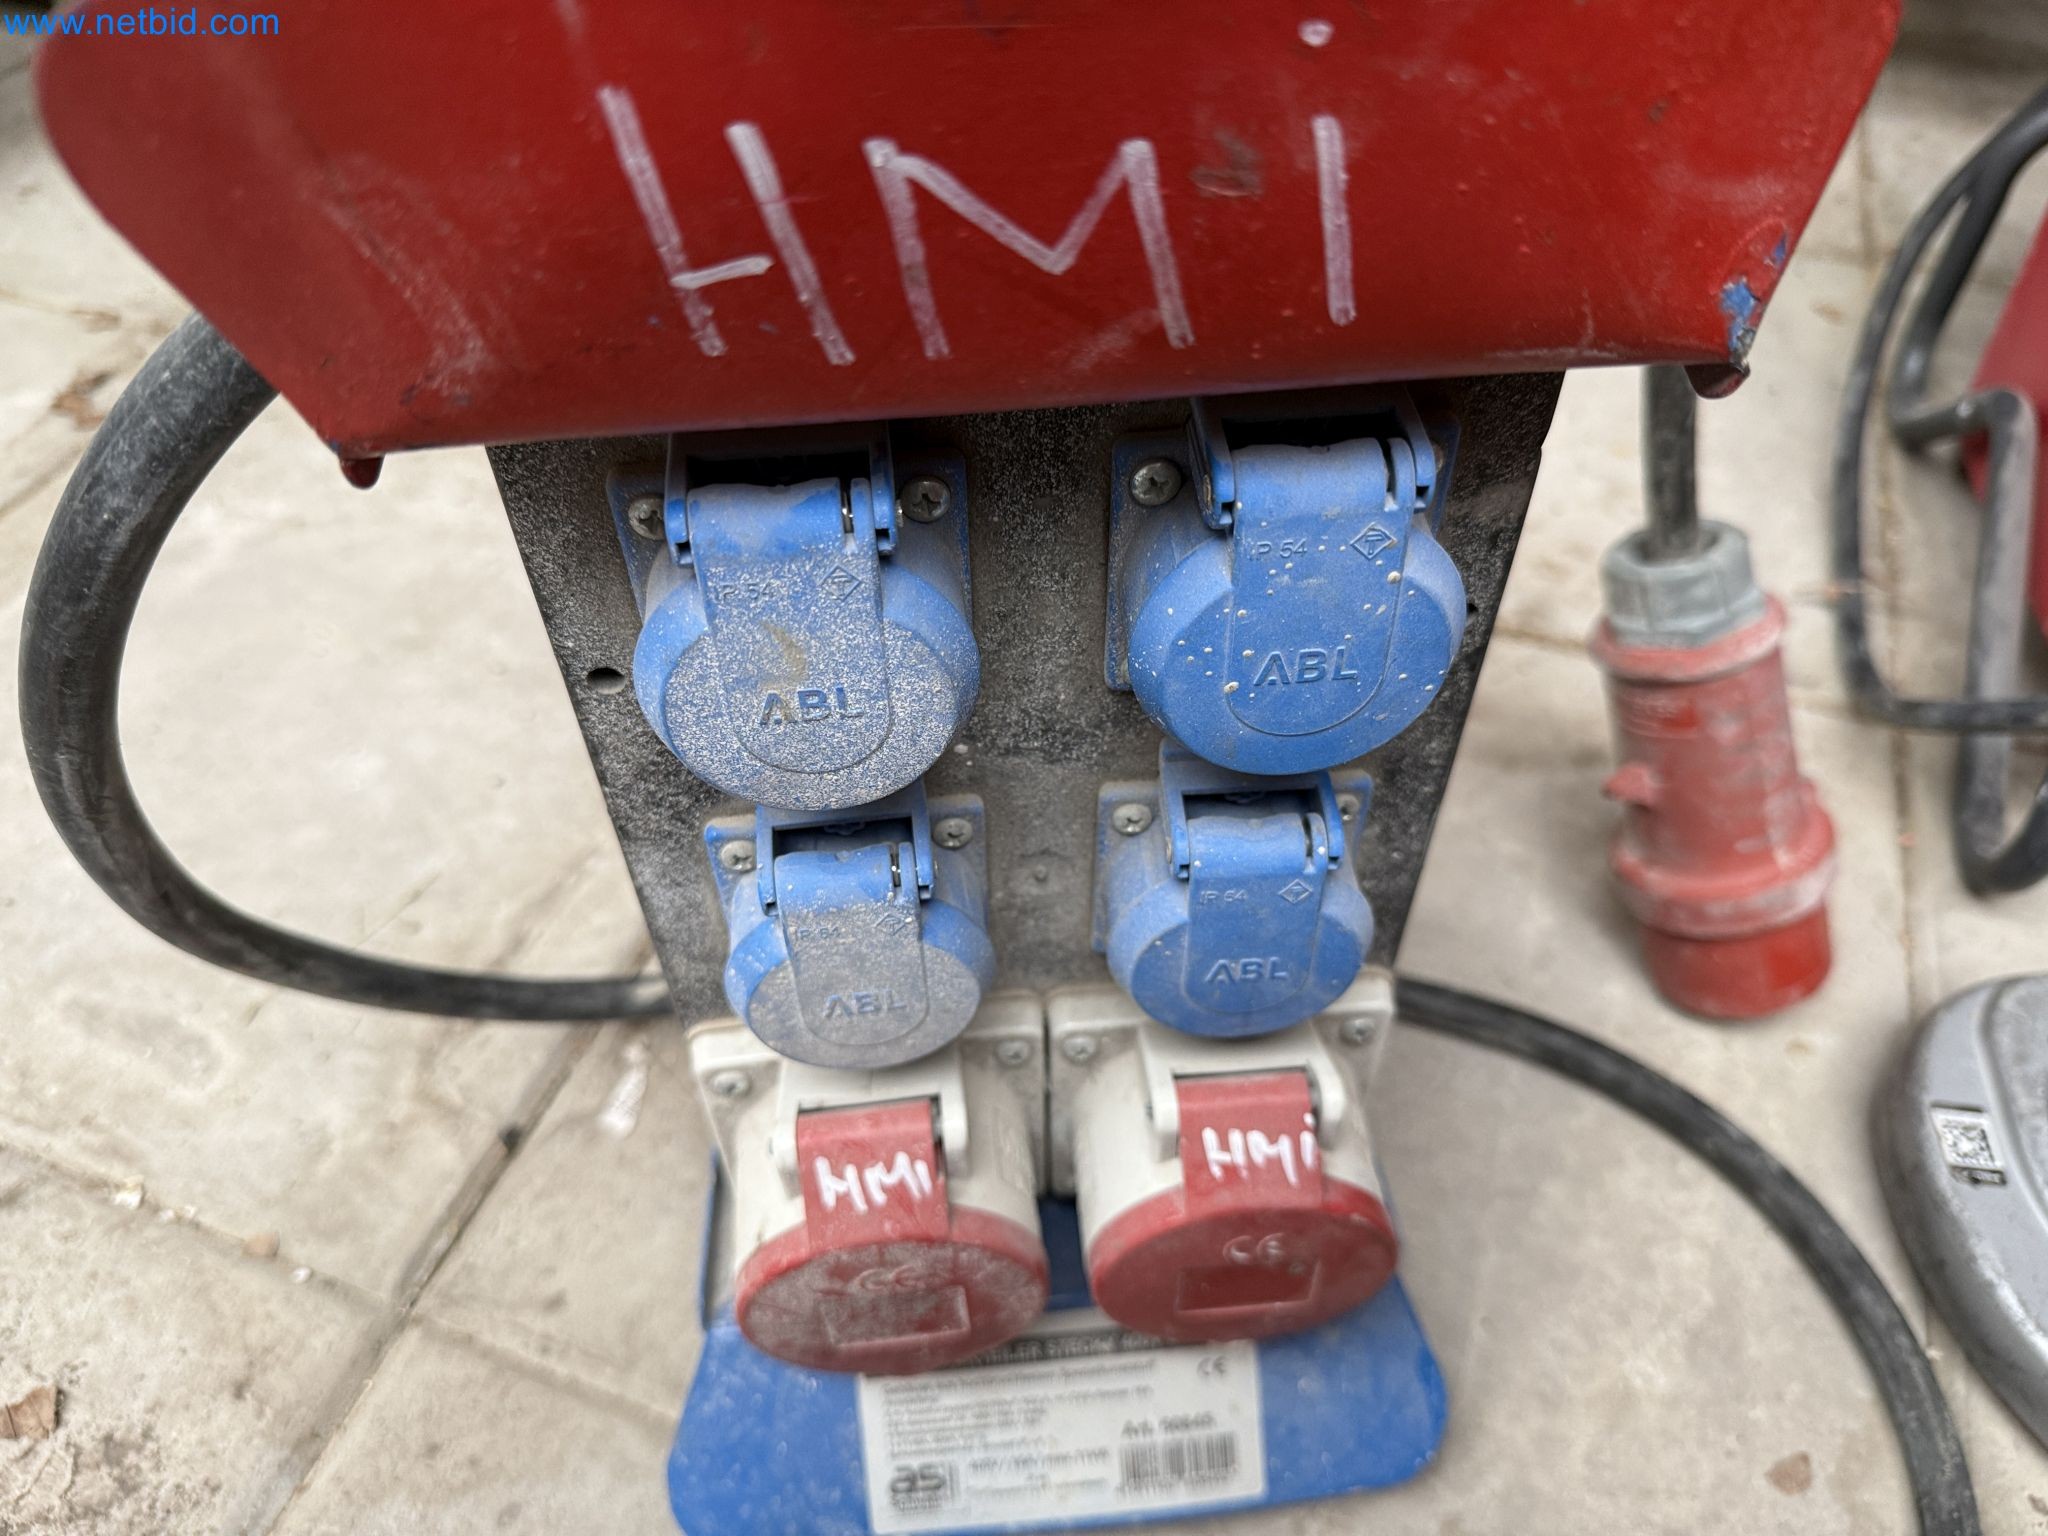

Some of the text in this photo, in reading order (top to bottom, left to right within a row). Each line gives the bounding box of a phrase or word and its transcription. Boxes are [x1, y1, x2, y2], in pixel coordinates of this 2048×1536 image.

[1279, 536, 1308, 558] 54
[747, 580, 776, 602] 54
[1253, 645, 1358, 687] ABL
[759, 685, 865, 726] ABL
[1204, 956, 1289, 984] ABL
[822, 989, 907, 1019] ABL
